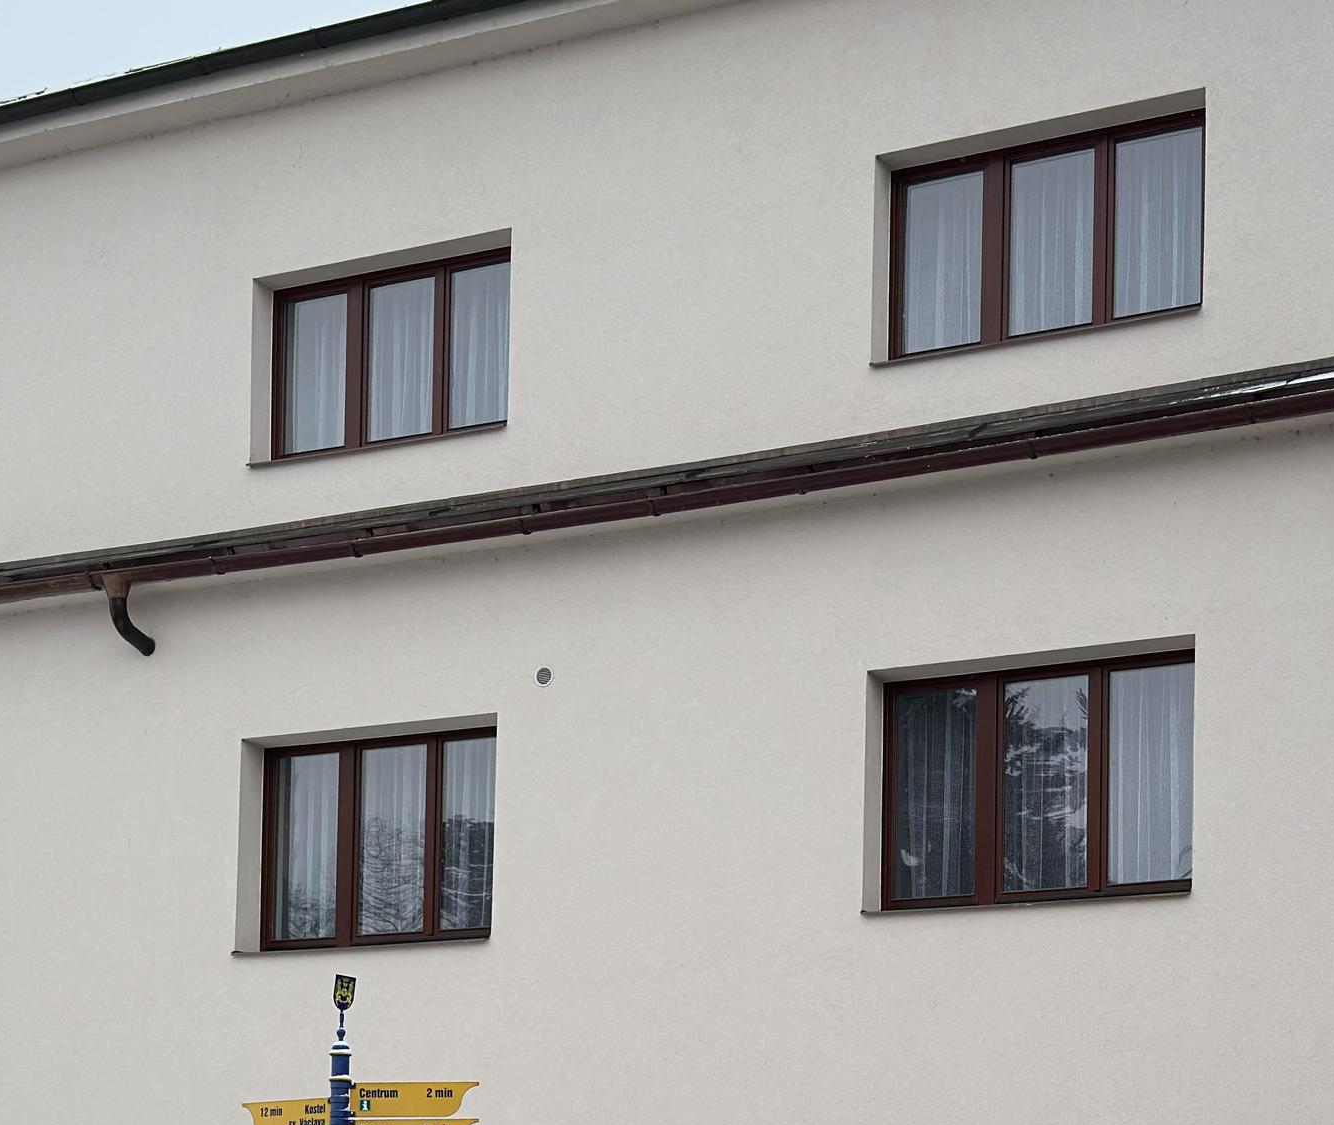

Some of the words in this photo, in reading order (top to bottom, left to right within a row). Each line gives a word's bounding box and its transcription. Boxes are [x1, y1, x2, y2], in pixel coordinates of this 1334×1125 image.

[359, 1088, 398, 1098] Centrum
[427, 1088, 432, 1098] 2
[435, 1087, 453, 1098] min
[261, 1107, 268, 1117] 12
[270, 1106, 282, 1117] min
[305, 1104, 325, 1114] Kostel
